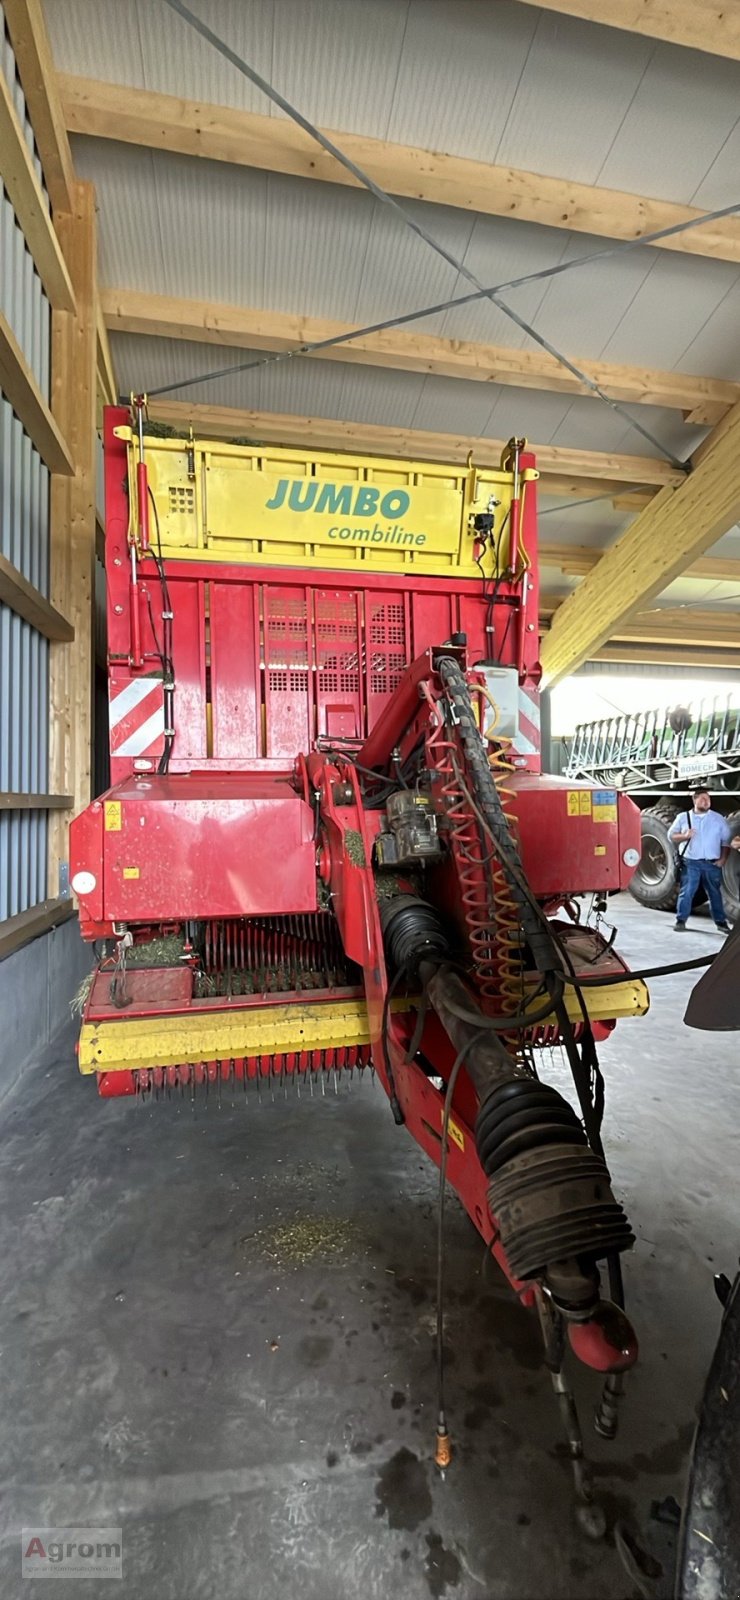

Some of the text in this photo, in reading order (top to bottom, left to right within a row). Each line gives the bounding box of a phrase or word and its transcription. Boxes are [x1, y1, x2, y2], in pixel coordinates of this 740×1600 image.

[265, 479, 410, 519] JUMBO
[328, 524, 426, 546] combiline
[680, 763, 714, 773] BOMECH
